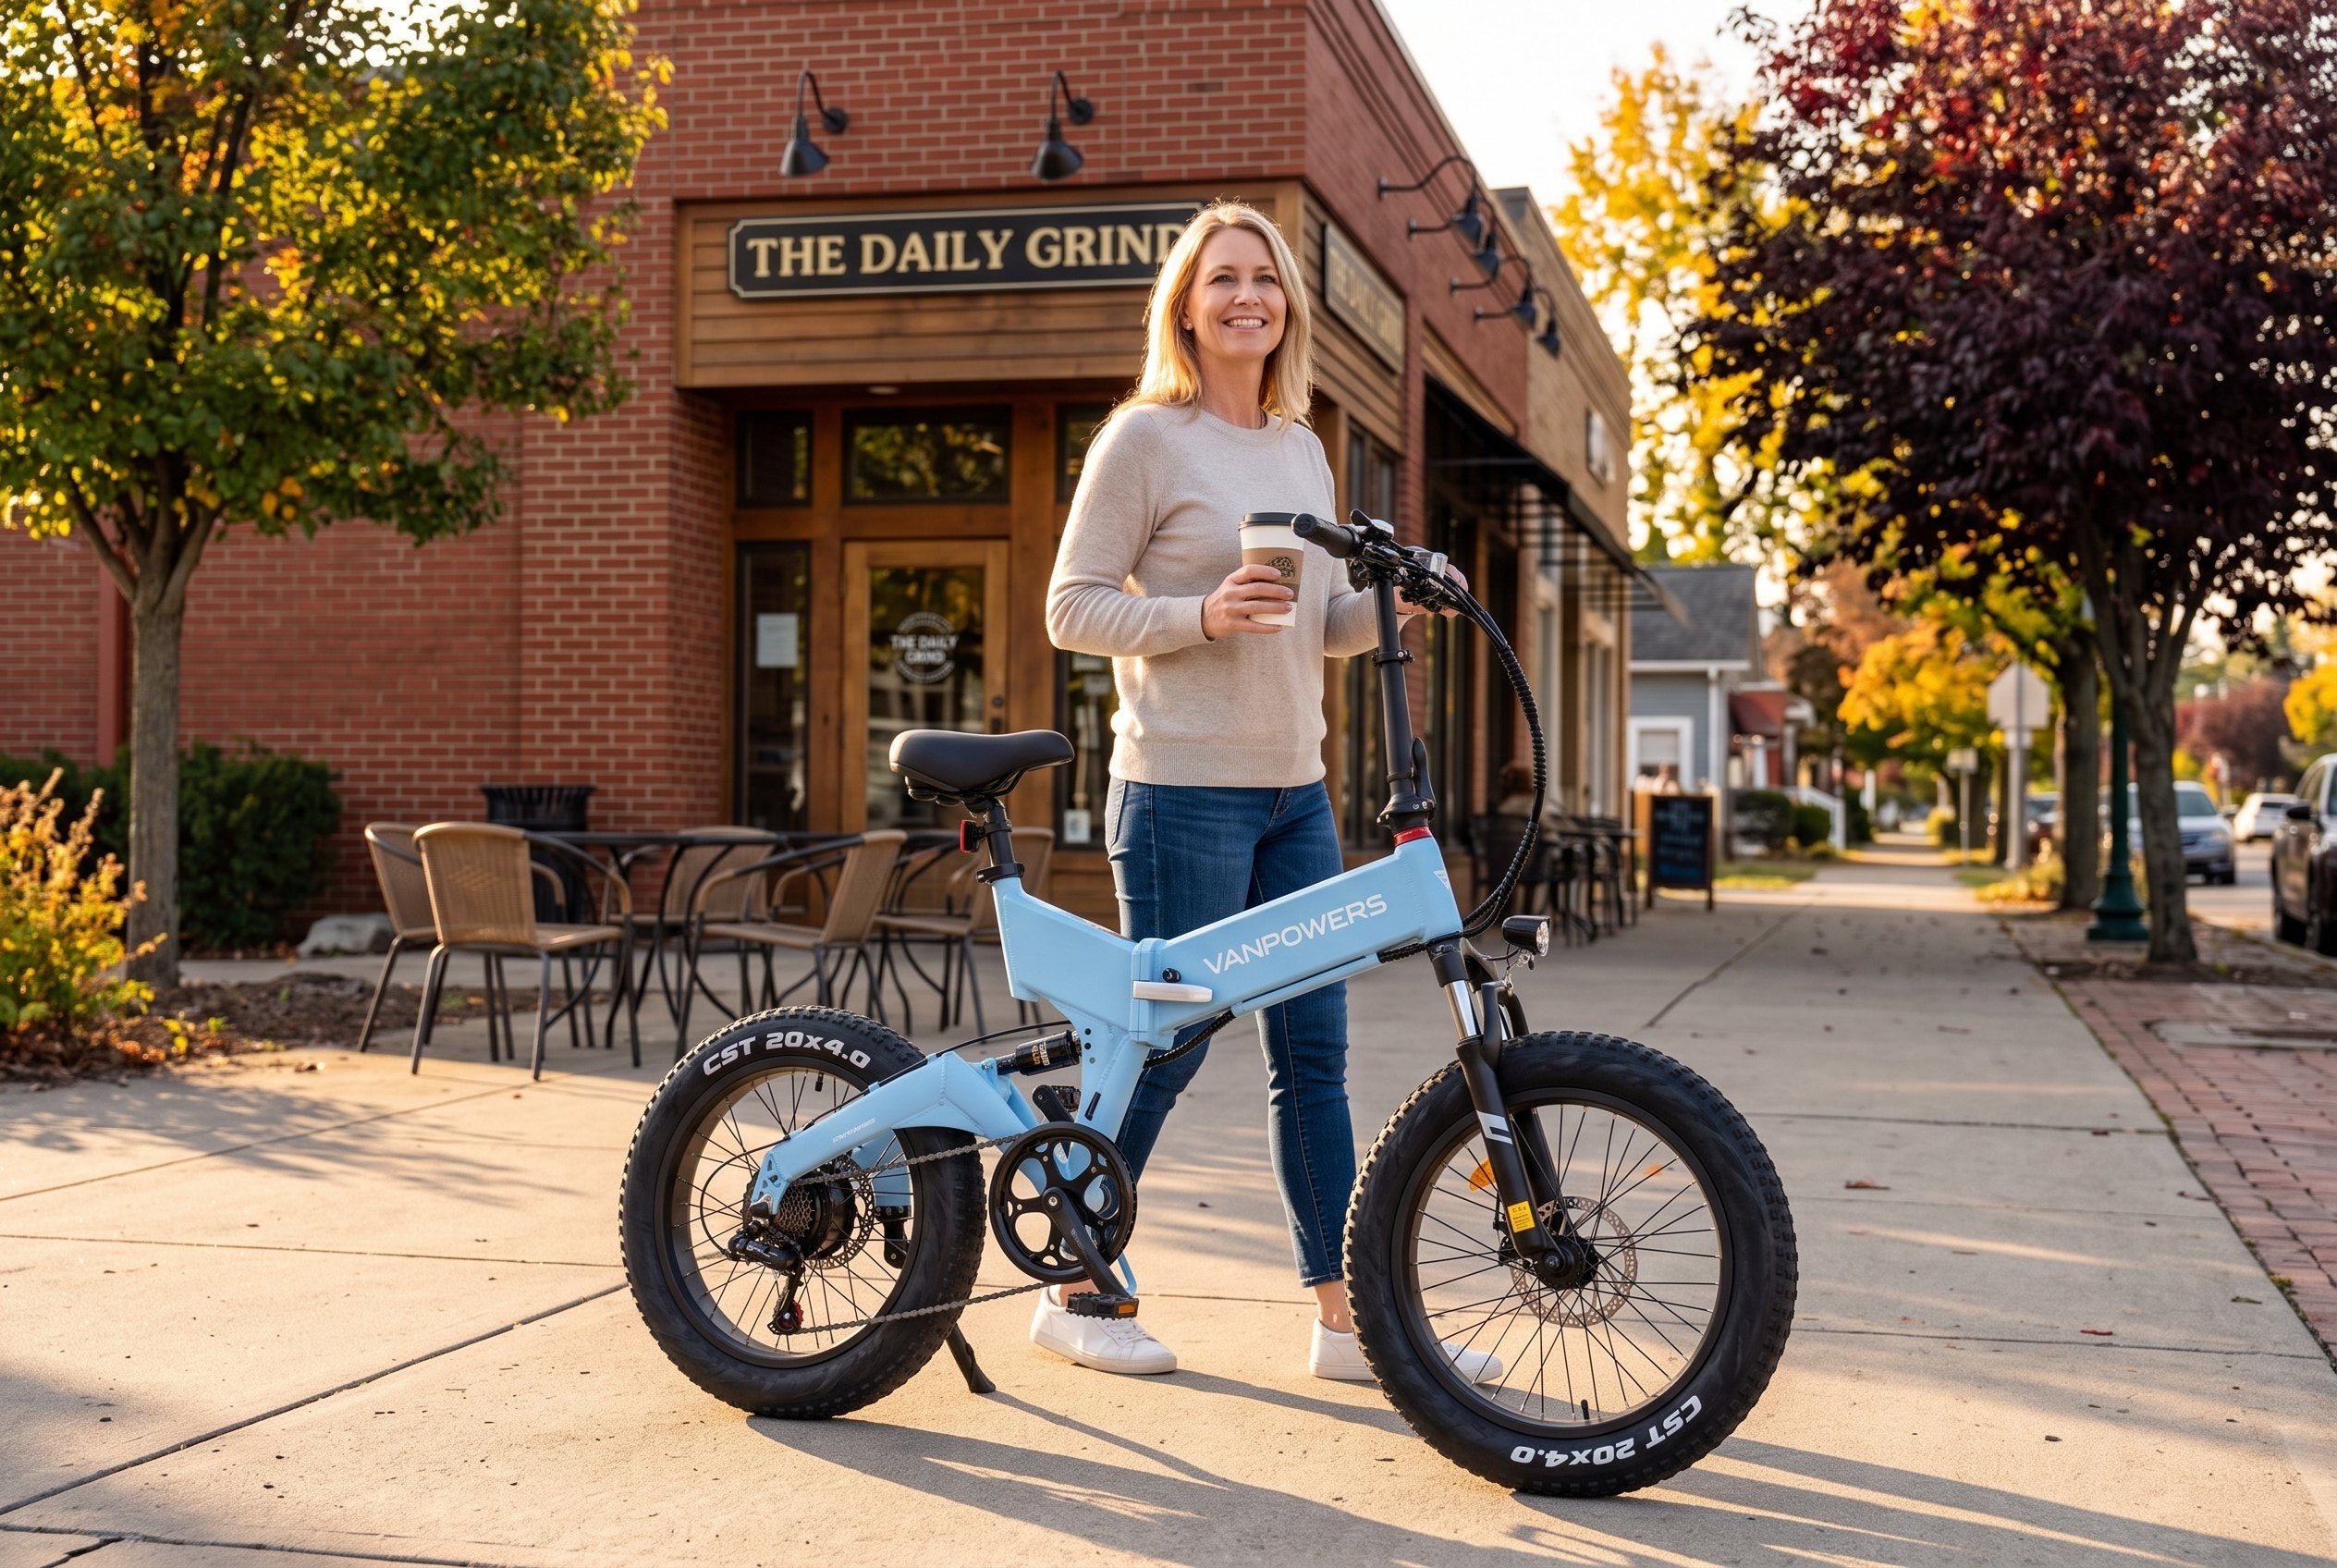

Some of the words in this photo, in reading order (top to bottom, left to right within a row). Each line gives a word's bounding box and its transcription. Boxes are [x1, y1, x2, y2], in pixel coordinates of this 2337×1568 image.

[746, 235, 846, 277] THE
[859, 228, 1014, 275] DAILY
[890, 635, 916, 650] THE
[1203, 893, 1388, 974] VANPOWERS
[703, 1036, 756, 1076] CST
[1646, 1395, 1702, 1450] CST
